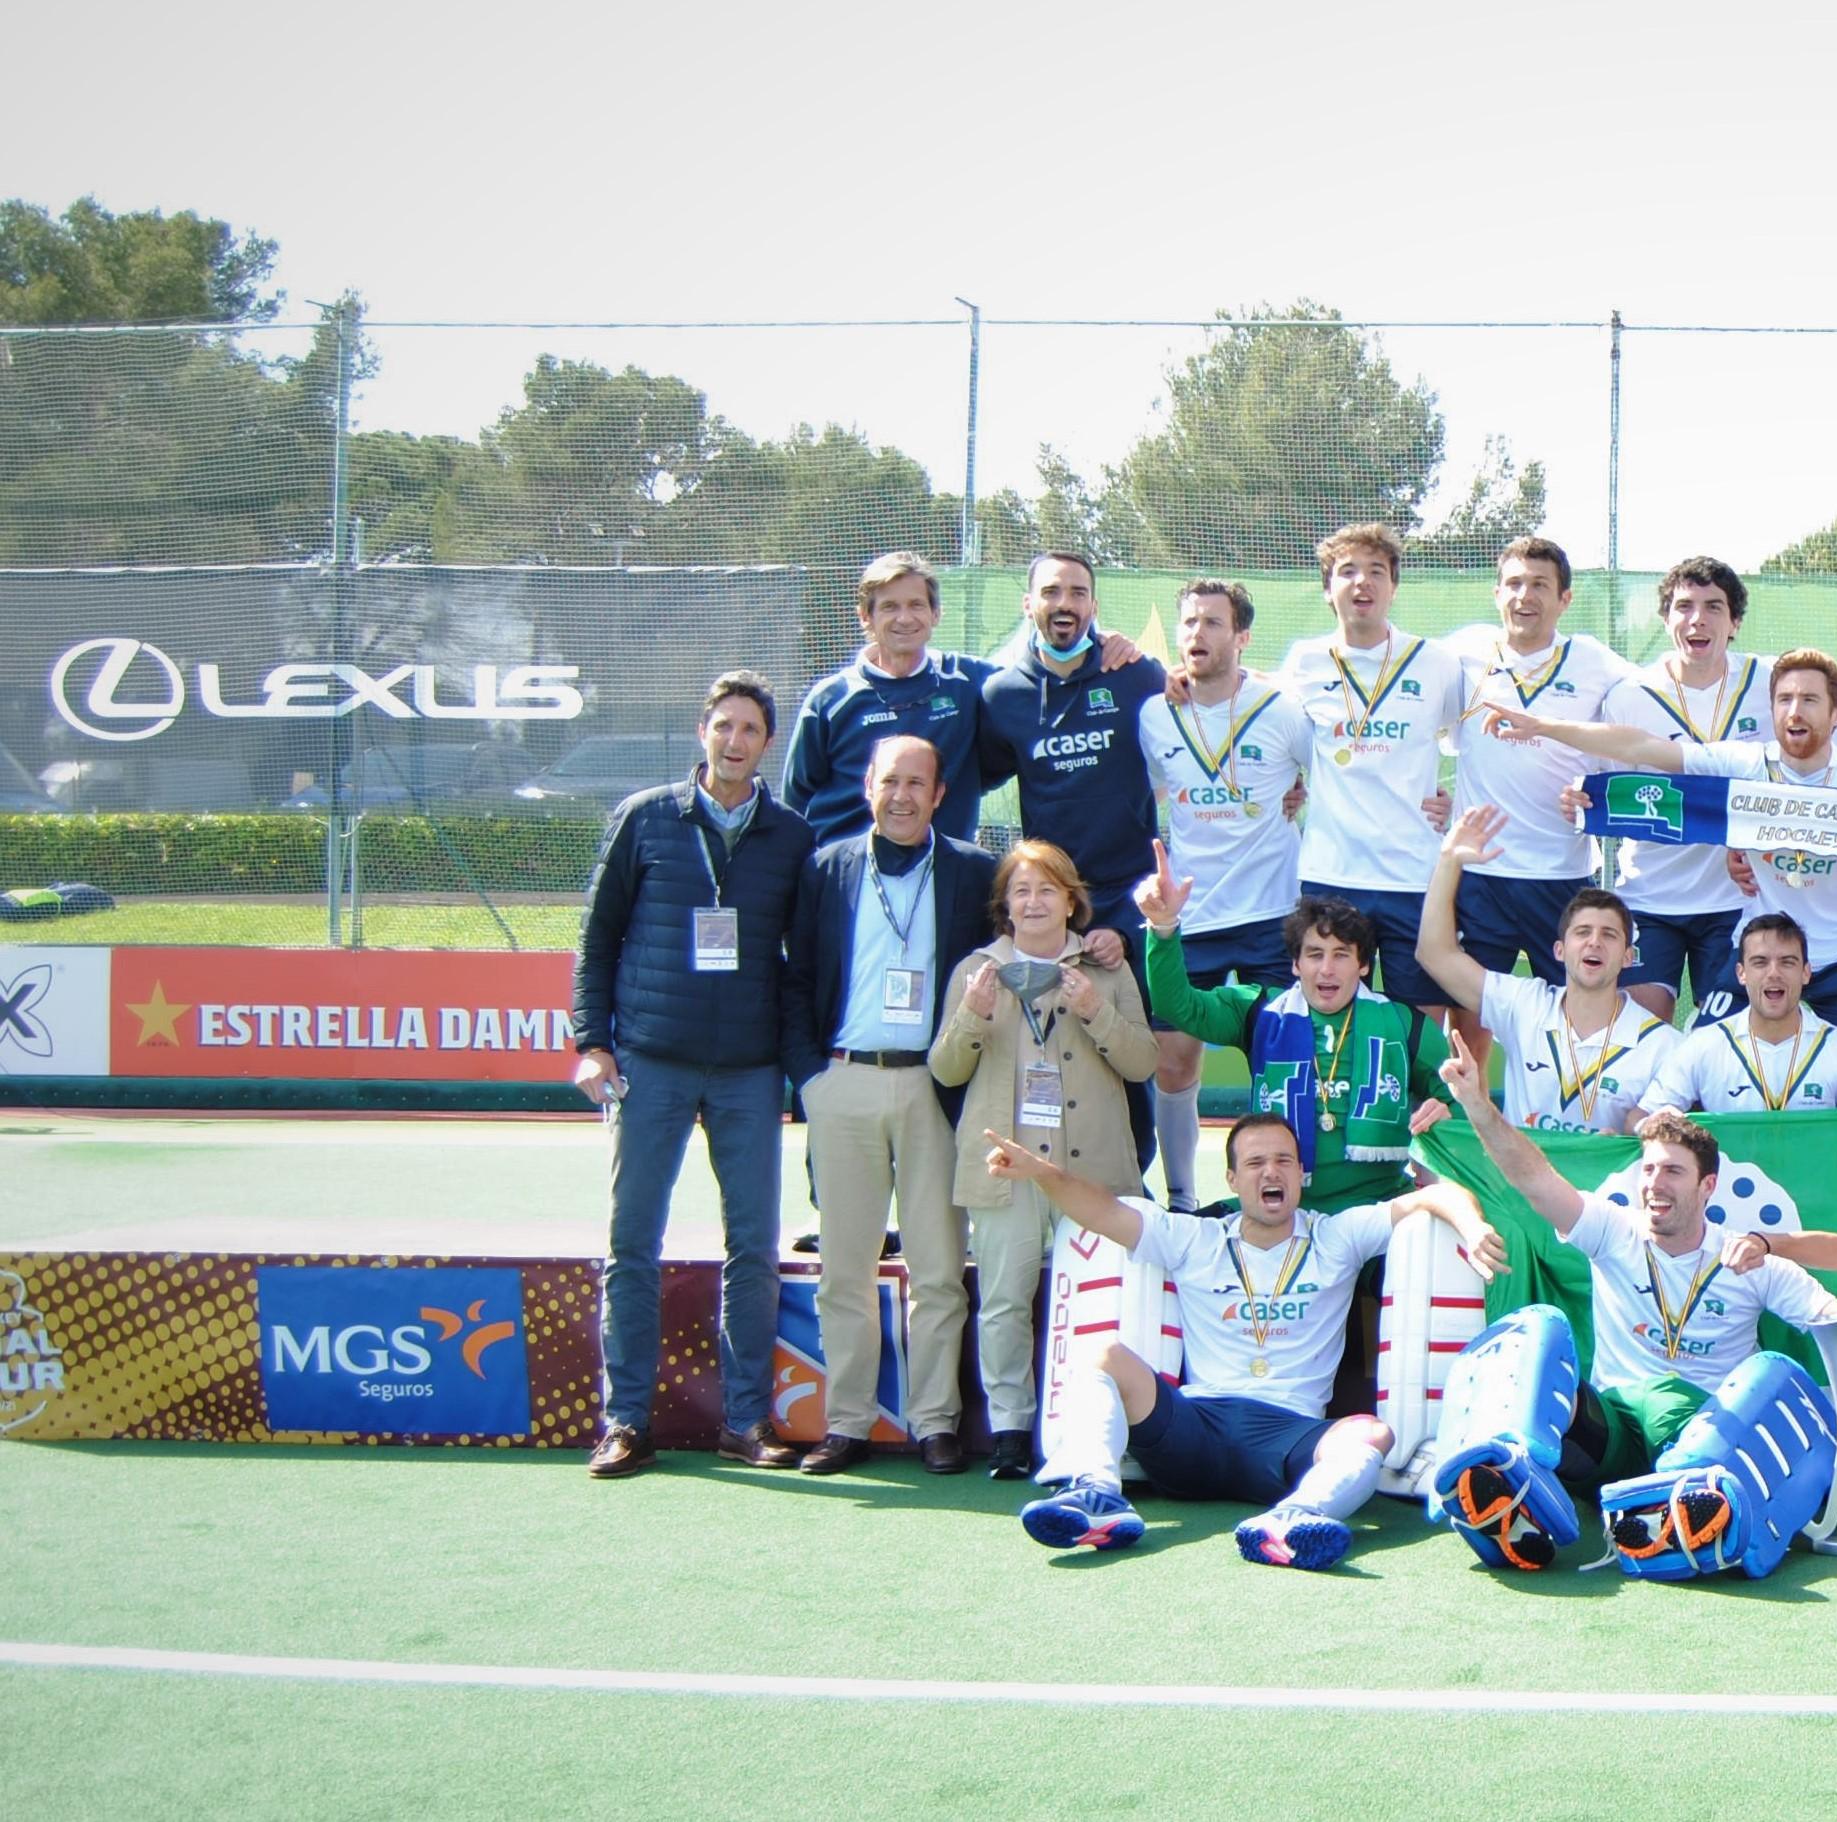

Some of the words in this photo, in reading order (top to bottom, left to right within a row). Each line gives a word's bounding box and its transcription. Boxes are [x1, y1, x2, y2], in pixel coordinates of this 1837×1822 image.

[199, 664, 583, 719] LEXUS
[1047, 729, 1114, 756] caser
[1054, 755, 1098, 771] seguros
[1189, 787, 1253, 805] caser
[1731, 795, 1781, 816] CLUB
[1784, 799, 1812, 817] DE
[1194, 809, 1237, 823] seguros
[1775, 855, 1836, 874] caser
[1701, 990, 1733, 1017] 10
[199, 1004, 429, 1049] ESTRELLA
[1324, 1024, 1334, 1053] 1
[1240, 1301, 1310, 1320] caser
[273, 1325, 431, 1374] MGS
[359, 1380, 433, 1401] Seguros
